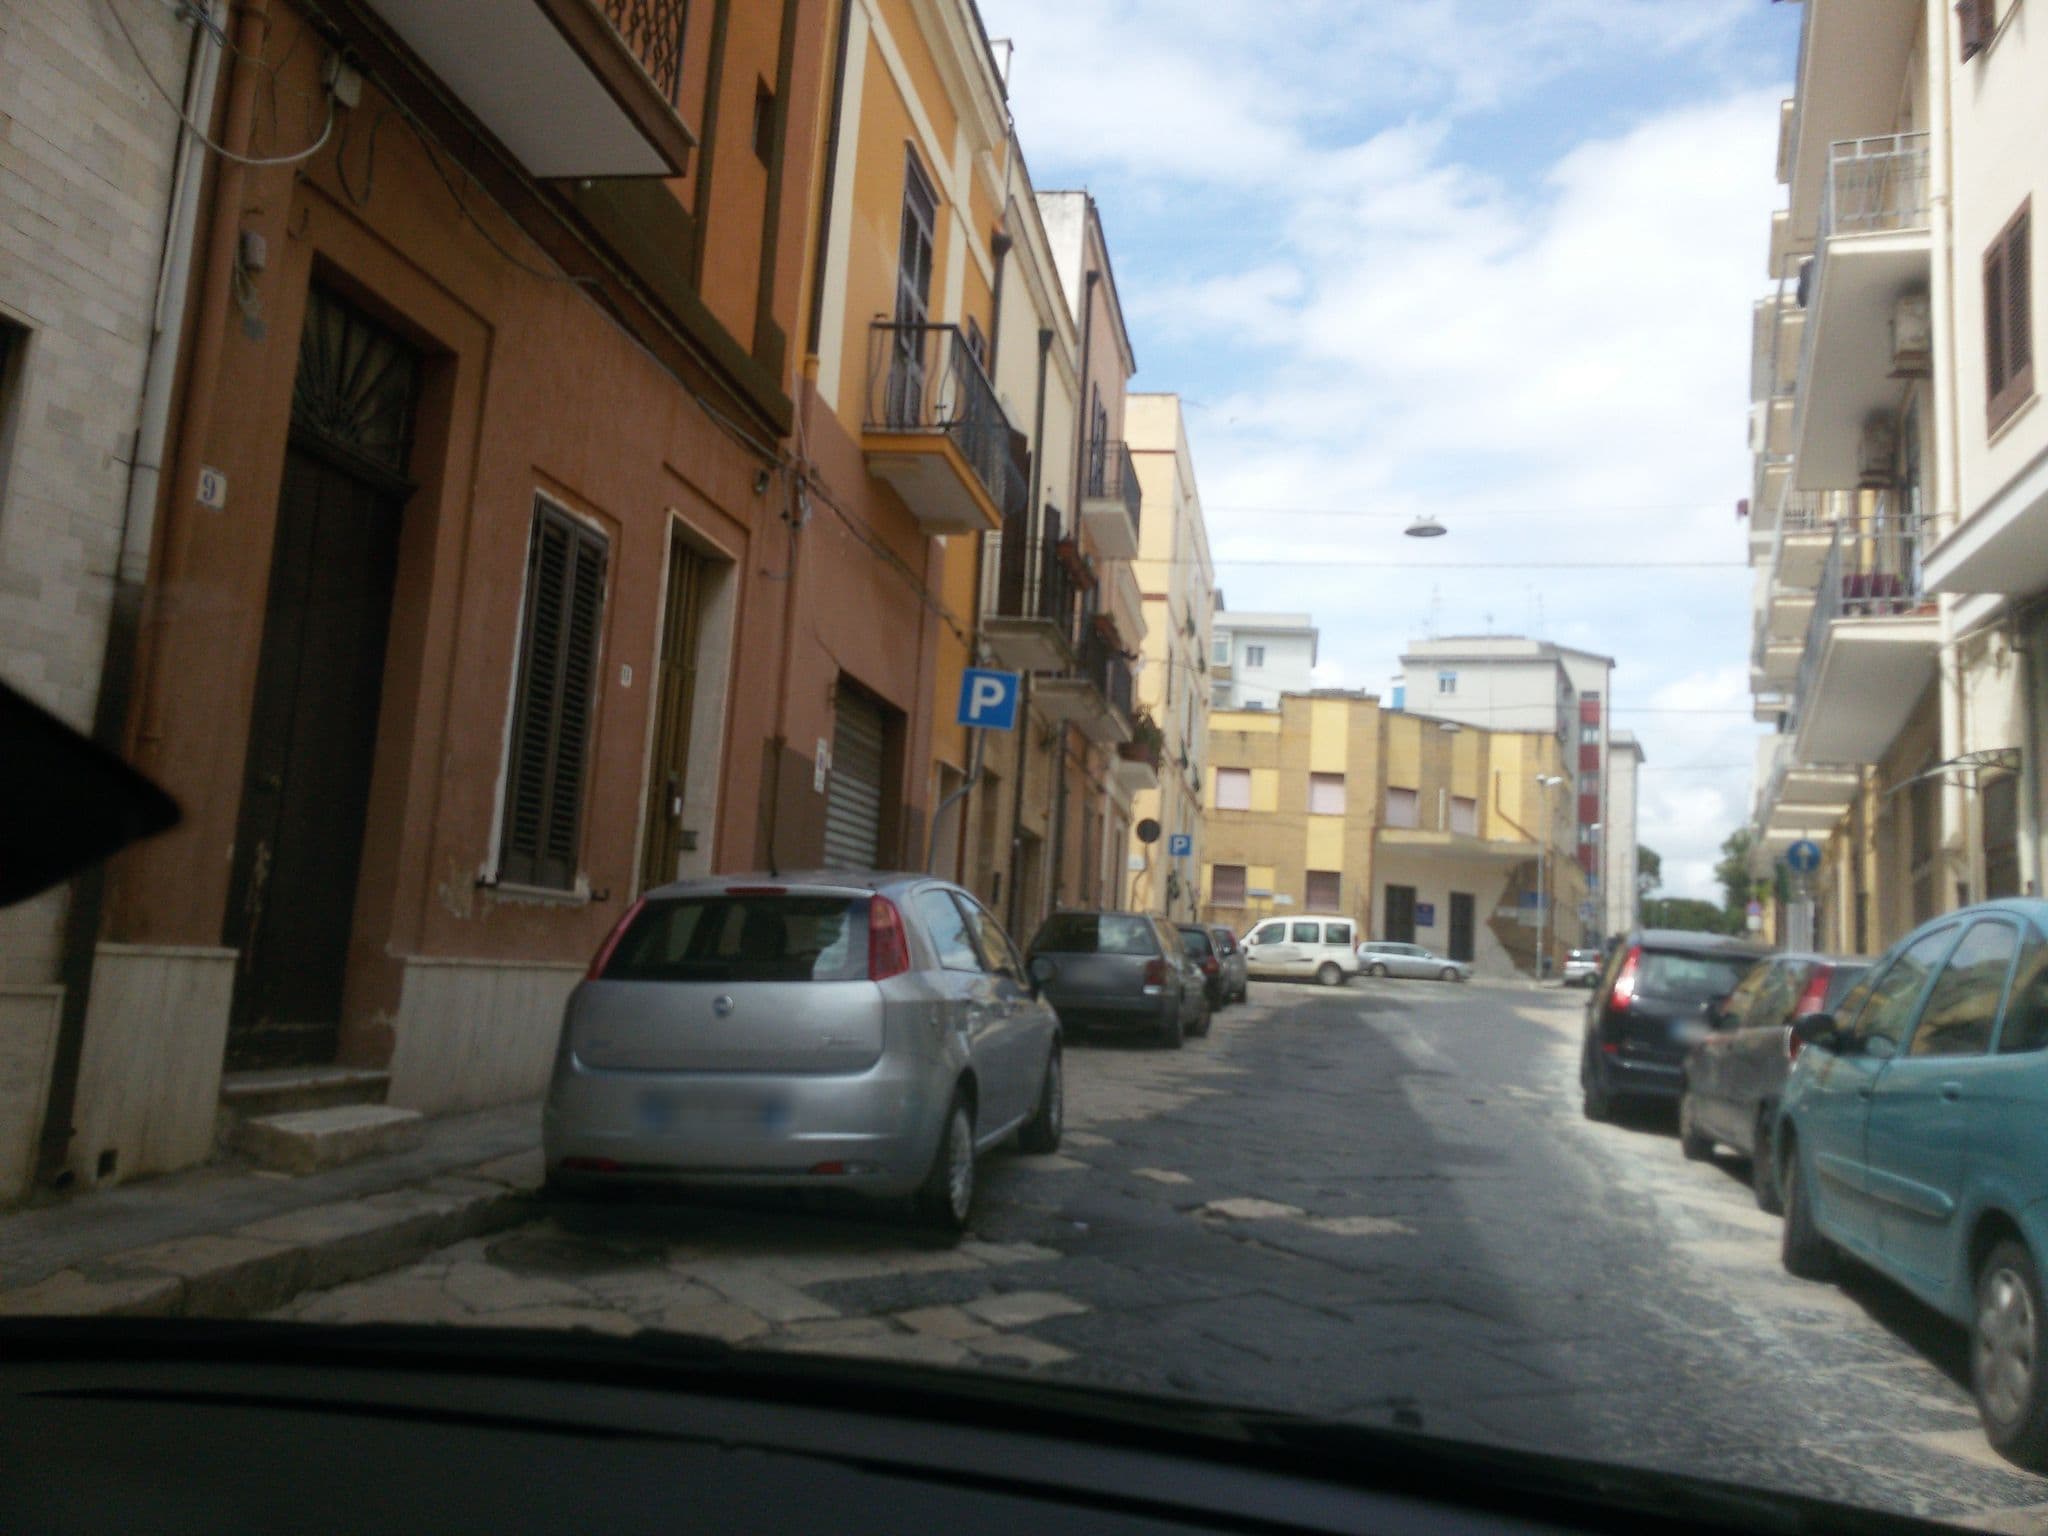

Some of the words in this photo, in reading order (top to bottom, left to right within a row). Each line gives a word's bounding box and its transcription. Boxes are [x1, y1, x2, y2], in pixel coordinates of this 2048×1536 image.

[203, 473, 216, 501] 9
[970, 677, 1005, 719] P
[1173, 837, 1187, 853] P
